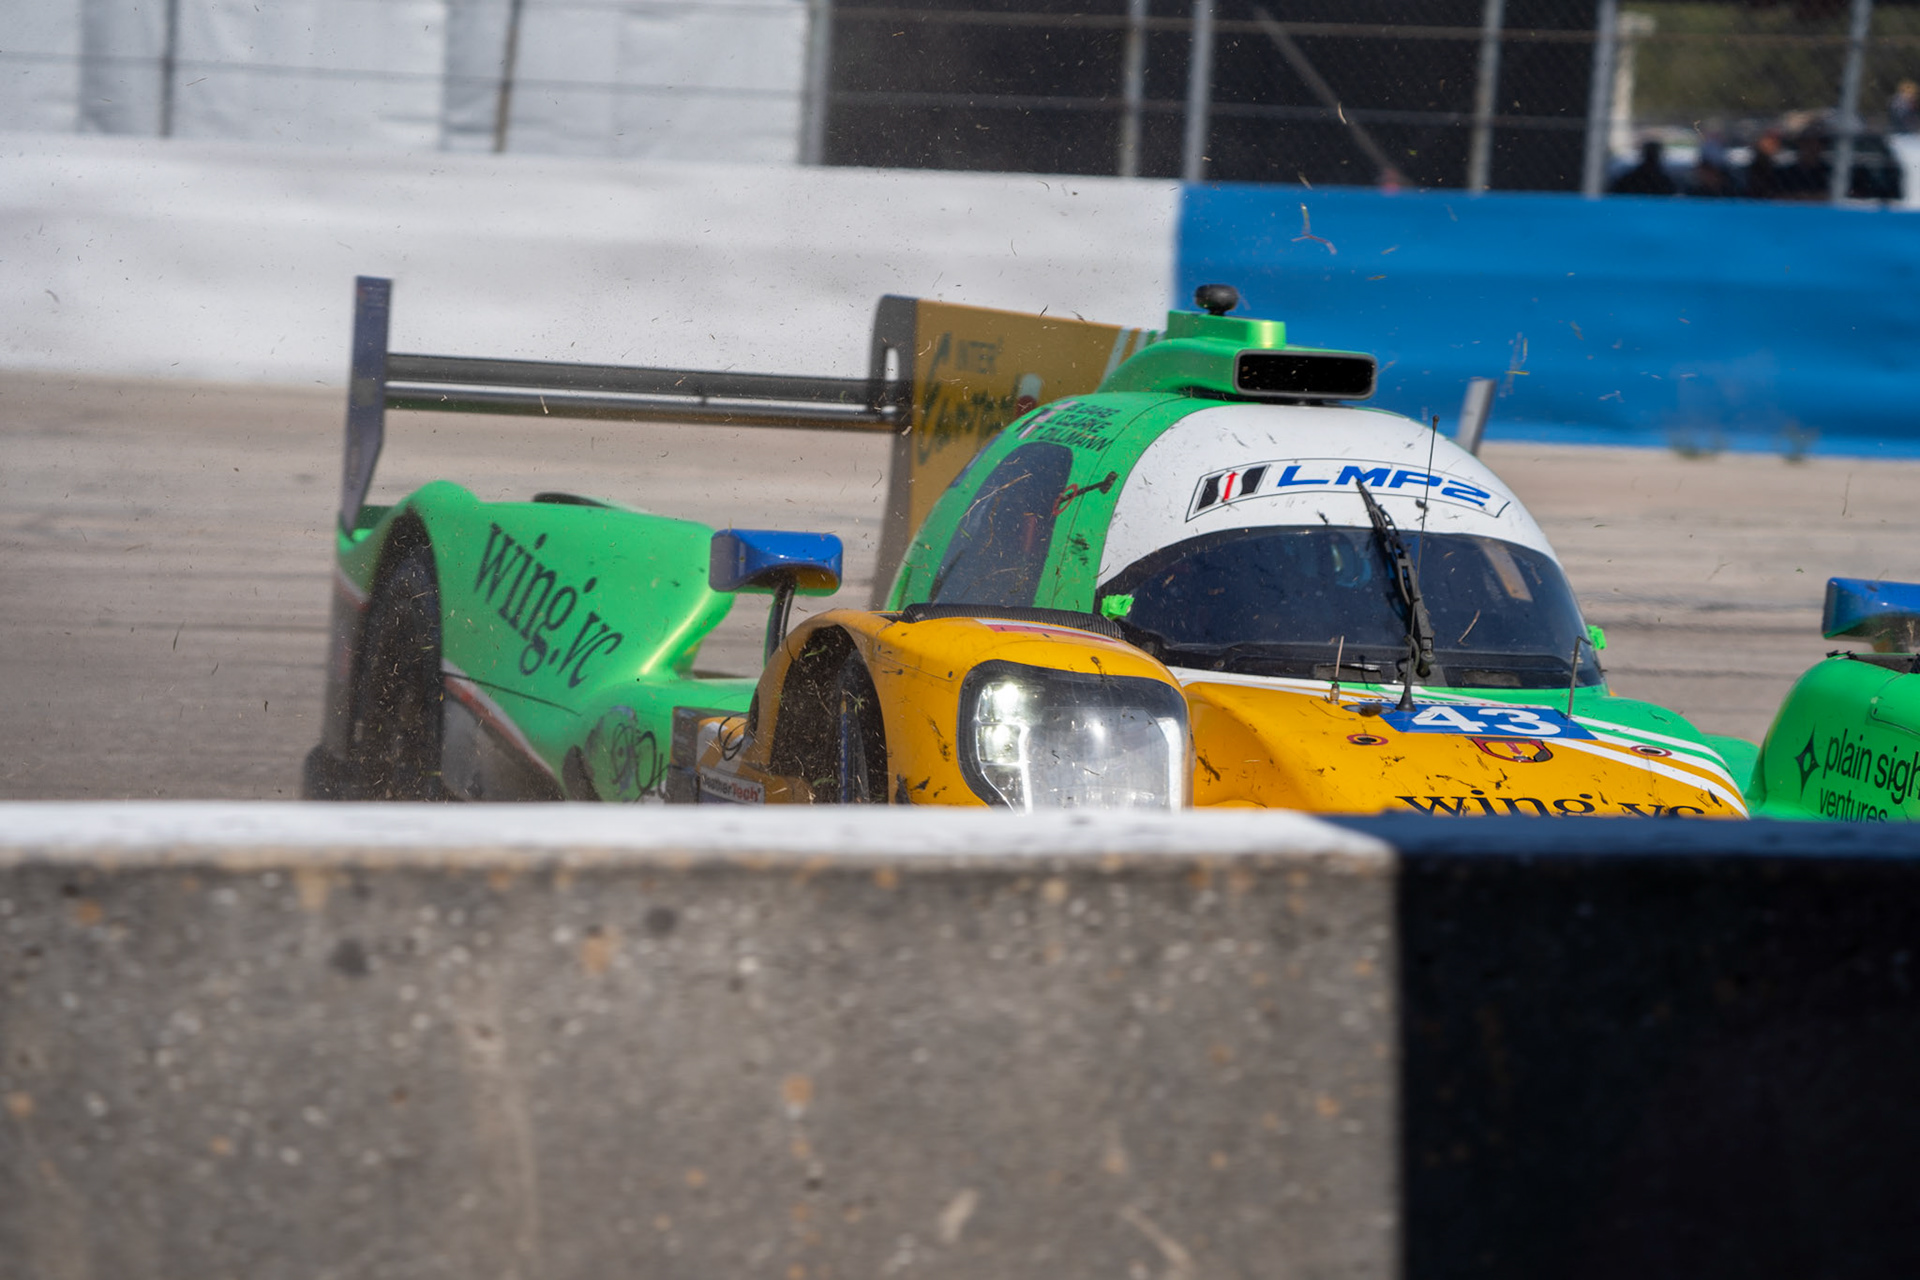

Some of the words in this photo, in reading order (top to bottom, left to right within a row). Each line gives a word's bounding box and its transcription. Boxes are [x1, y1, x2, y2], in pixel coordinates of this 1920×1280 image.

[1276, 465, 1491, 507] LMP2
[474, 522, 625, 689] wing.vc
[1411, 706, 1562, 736] 43
[1822, 728, 1873, 783] plain
[1820, 787, 1889, 822] ventures
